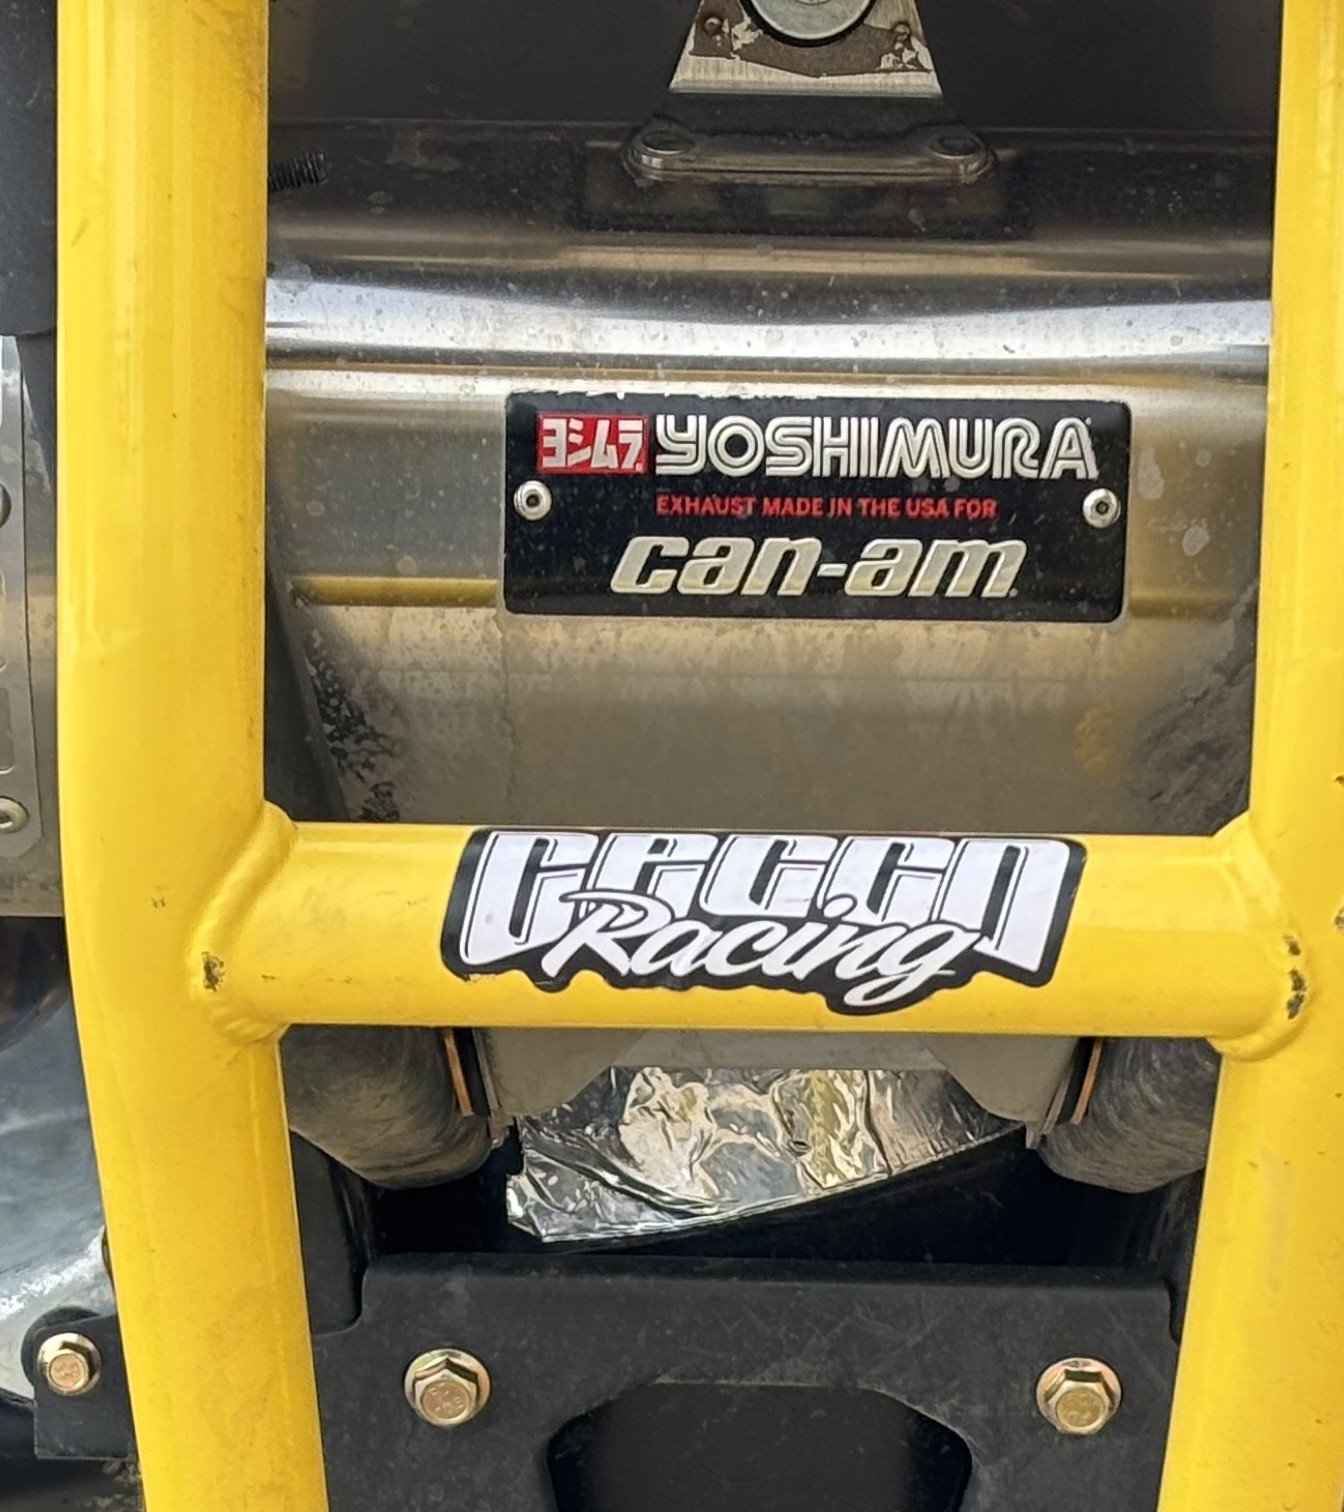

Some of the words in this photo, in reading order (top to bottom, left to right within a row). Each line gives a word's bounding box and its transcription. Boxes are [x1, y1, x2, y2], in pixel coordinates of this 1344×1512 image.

[542, 418, 642, 473] ヨシムラ
[656, 414, 1100, 480] YOSHIMURA
[656, 495, 754, 516] EXHAUST
[762, 496, 823, 517] MADE
[828, 496, 852, 517] IN
[859, 497, 901, 518] THE
[905, 497, 950, 519] USA
[954, 498, 998, 519] FOR
[611, 536, 1028, 598] can-am
[541, 889, 986, 1006] Racing
